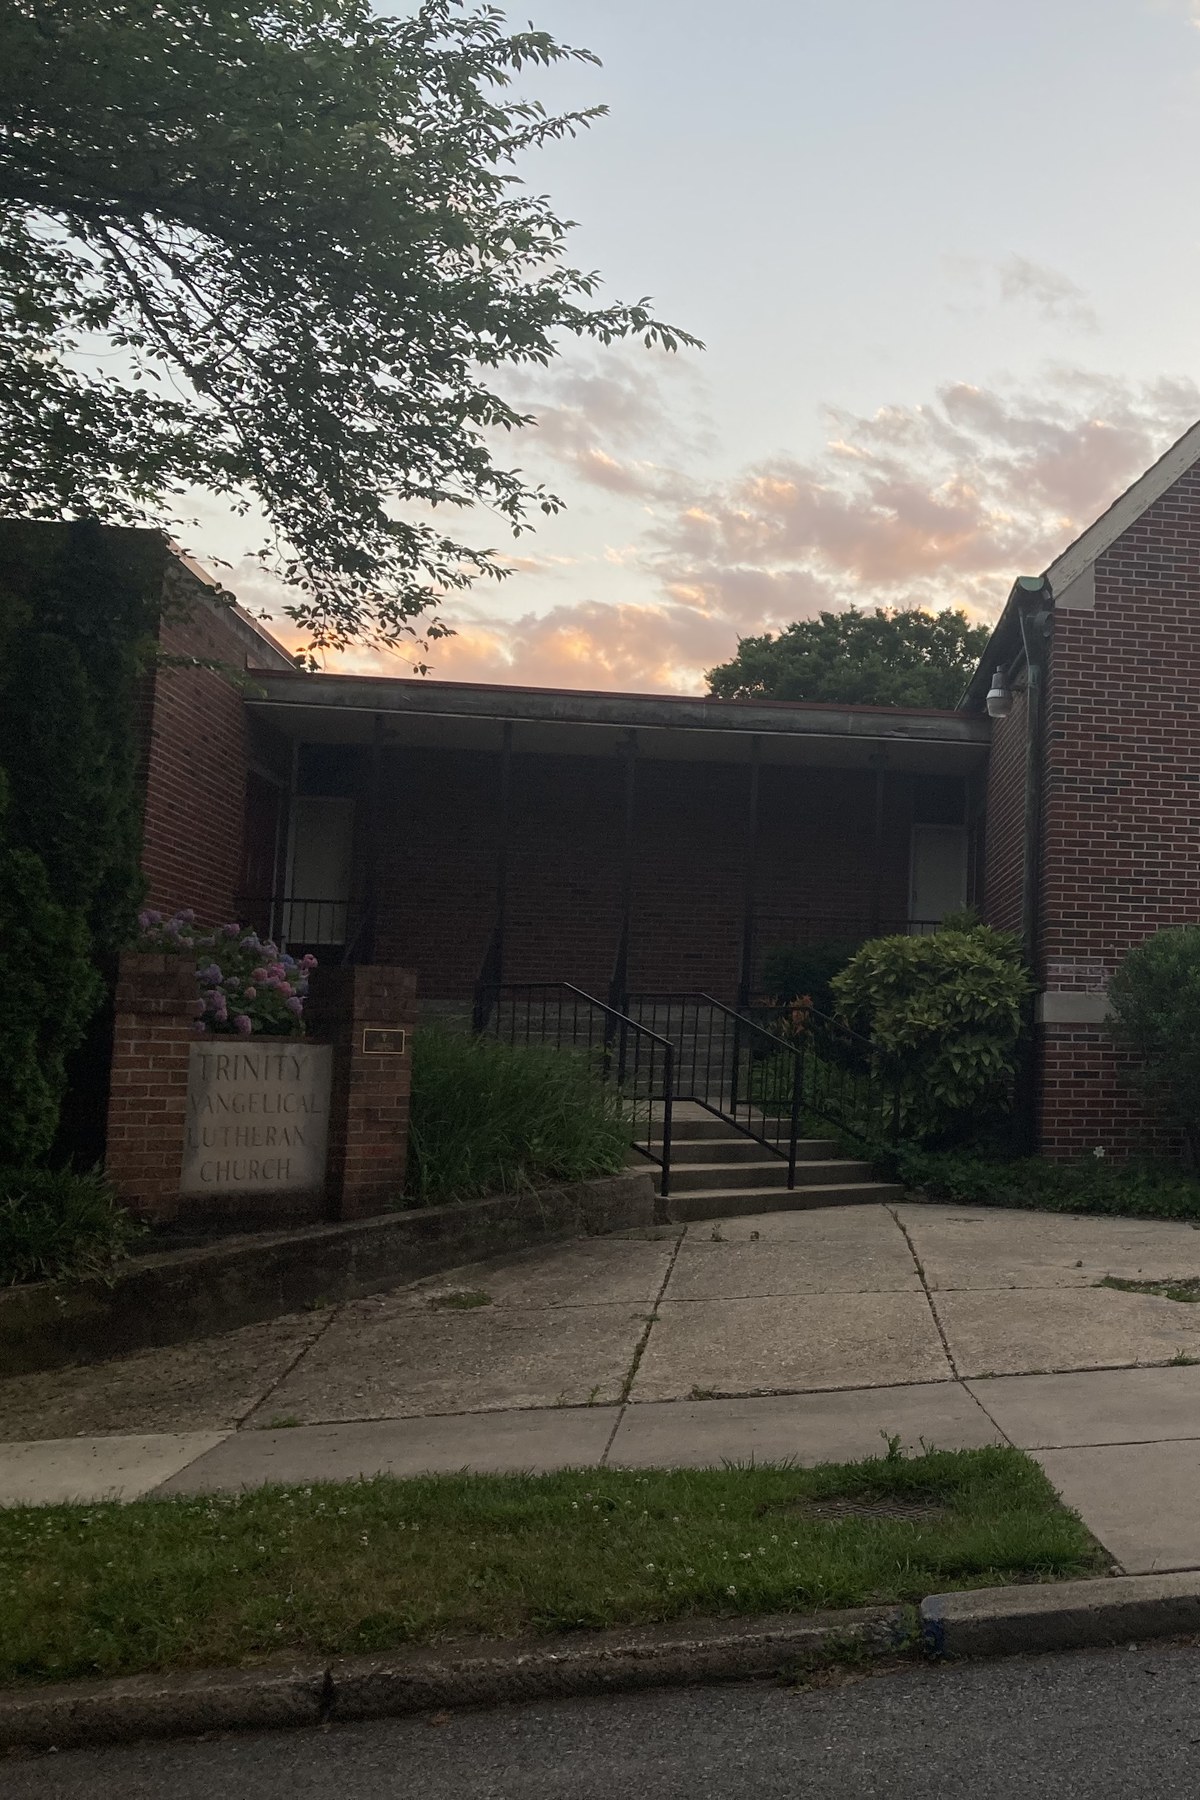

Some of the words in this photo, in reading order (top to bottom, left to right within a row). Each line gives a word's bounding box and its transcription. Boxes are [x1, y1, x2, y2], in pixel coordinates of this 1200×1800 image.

[198, 1054, 309, 1081] TRINITY
[190, 1092, 322, 1114] VANGELICAL
[187, 1126, 306, 1149] LUTHERAN
[200, 1158, 291, 1183] CHURCH
